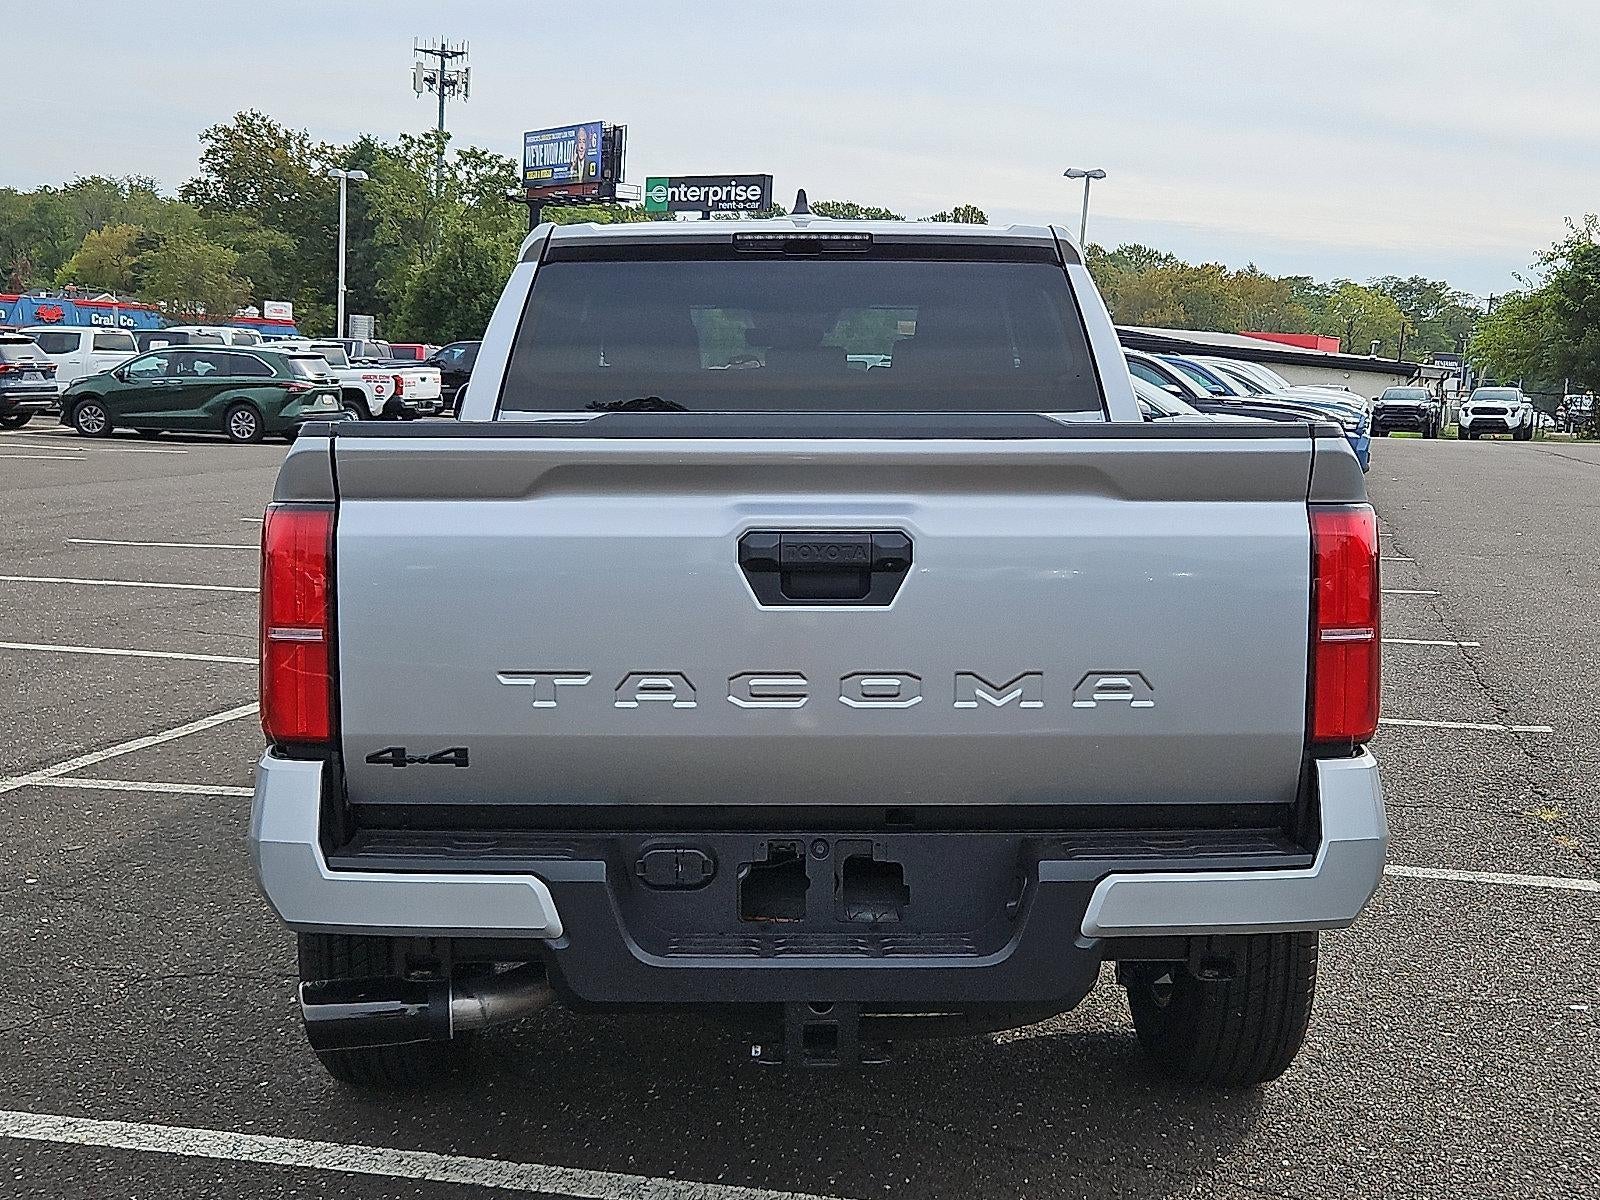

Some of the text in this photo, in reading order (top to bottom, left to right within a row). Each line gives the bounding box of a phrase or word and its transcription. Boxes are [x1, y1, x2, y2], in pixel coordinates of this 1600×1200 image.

[651, 180, 762, 207] enterprise
[718, 201, 760, 210] rent-a-car
[119, 315, 138, 327] Co.
[784, 544, 868, 560] TOYOTA
[496, 670, 1155, 708] TACOMA
